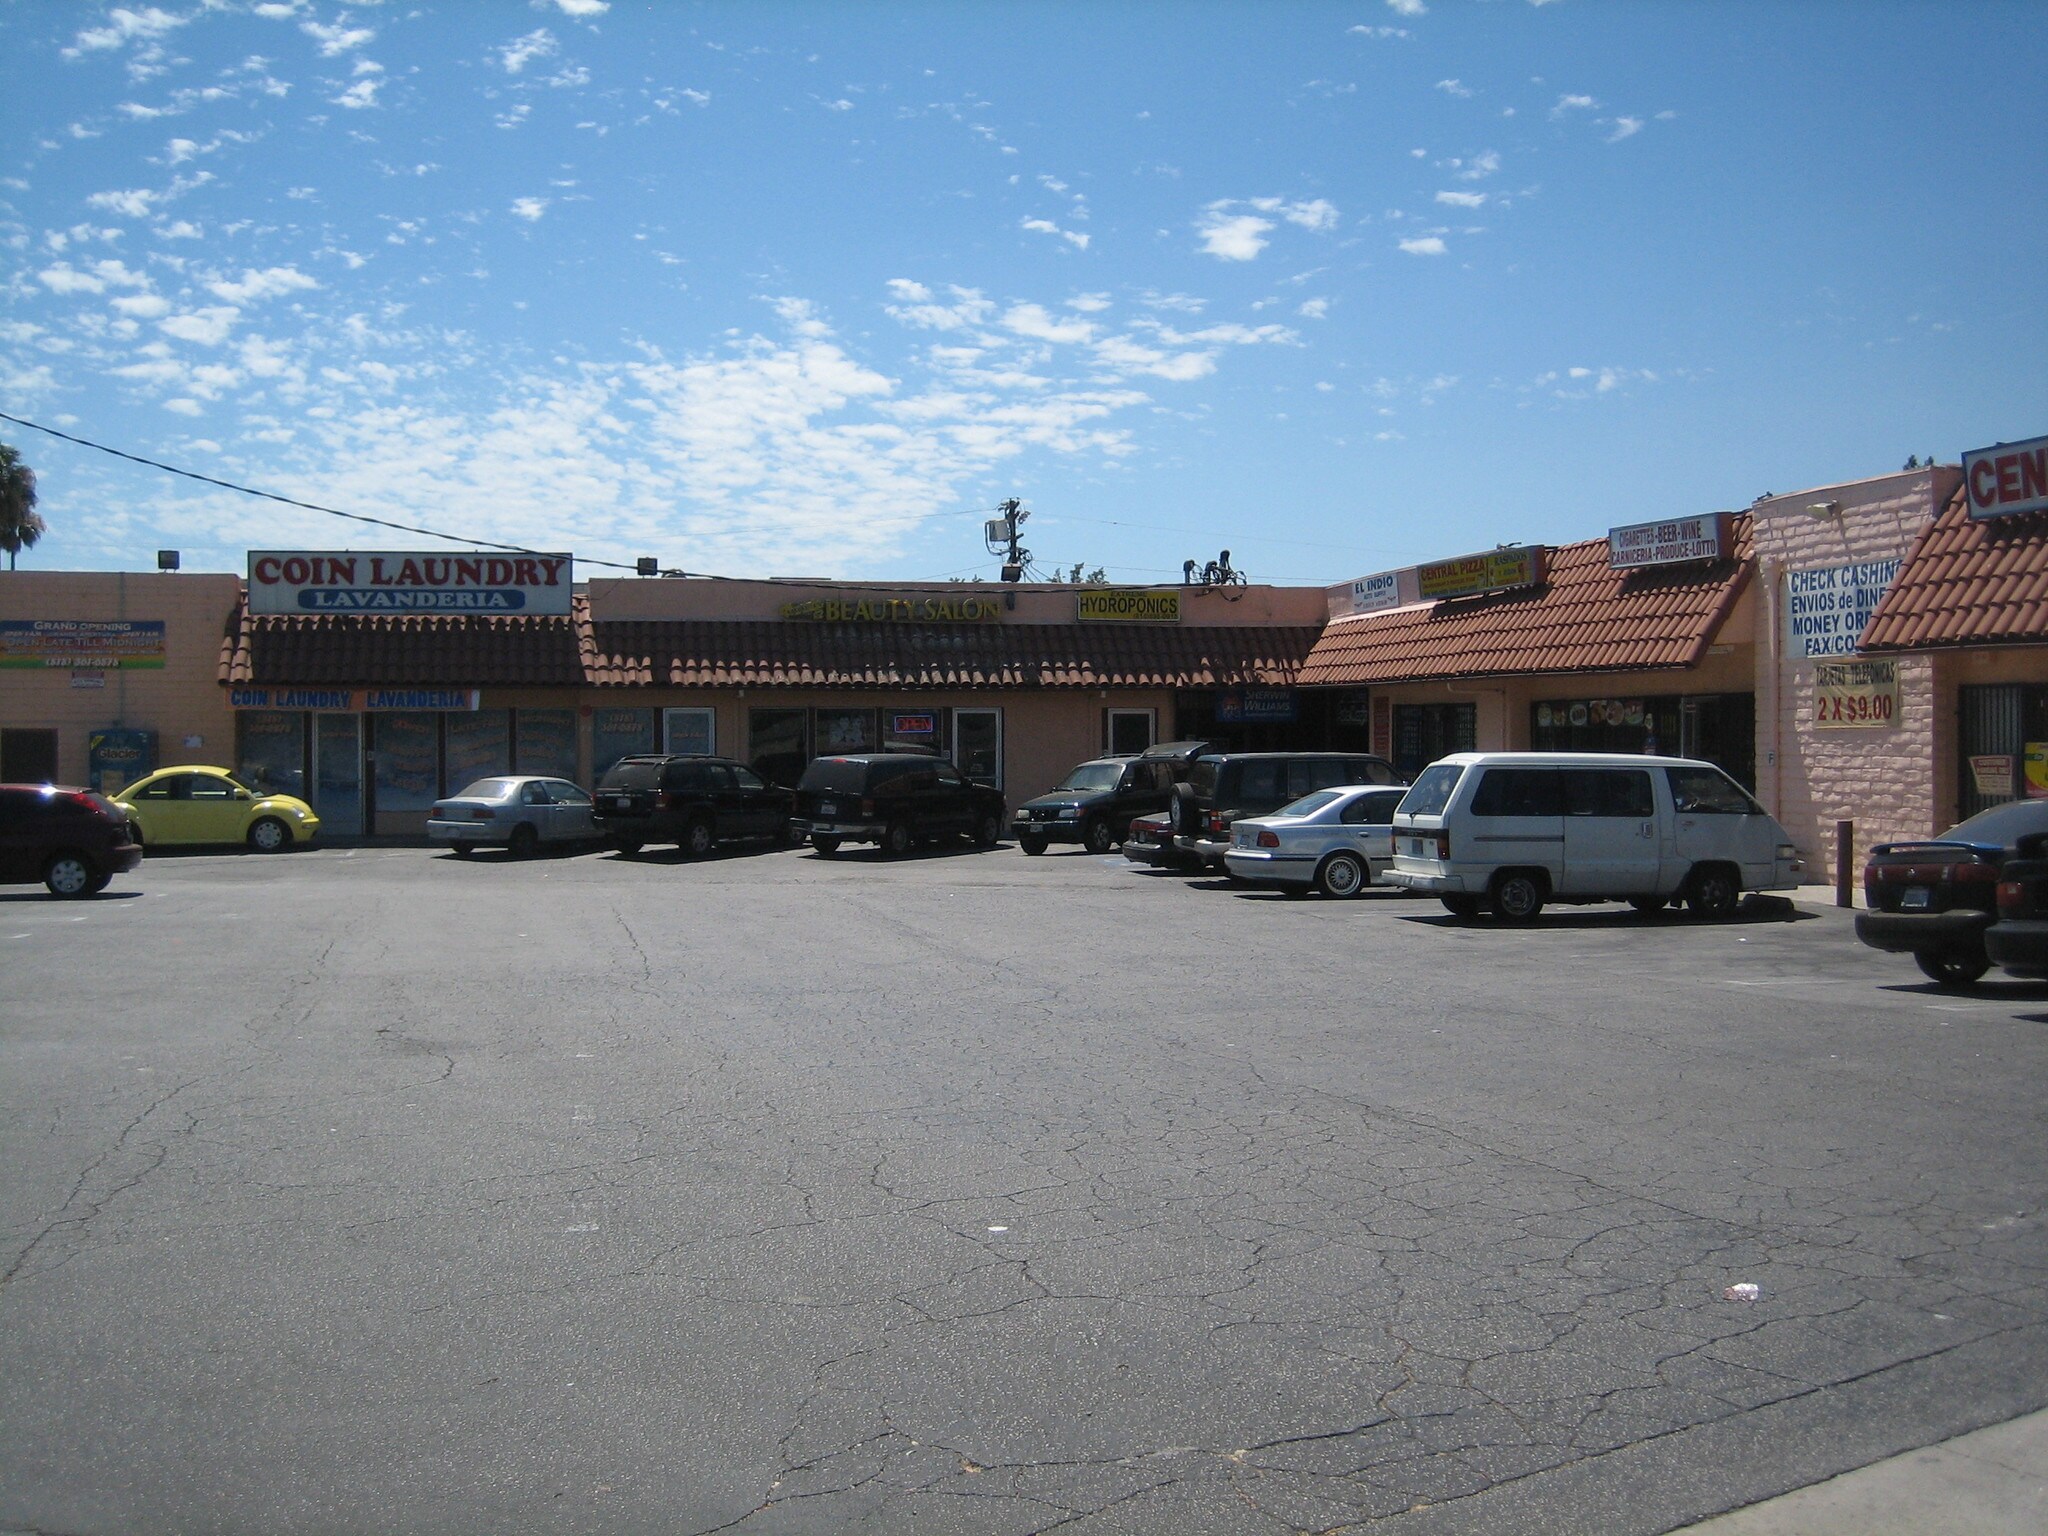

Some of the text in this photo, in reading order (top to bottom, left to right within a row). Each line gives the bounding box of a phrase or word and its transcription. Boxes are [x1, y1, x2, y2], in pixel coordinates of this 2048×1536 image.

[1970, 447, 2048, 508] CEN
[255, 557, 566, 587] COIN LAUNDRY
[1420, 563, 1459, 582] CENTRAL
[1460, 558, 1486, 575] PIZZA
[1355, 576, 1394, 594] EL INDIO
[1791, 568, 1836, 593] CHECK
[315, 591, 509, 608] LAVANDERIA
[1080, 597, 1178, 614] HYDROPONICS
[1791, 592, 1835, 614] ENVIOS
[1839, 592, 1853, 610] de
[825, 598, 916, 622] BEAUTY
[924, 598, 1000, 621] SALON
[34, 620, 132, 632] GRAND OPENING
[1793, 615, 1840, 636] MONEY
[7, 637, 161, 647] OPEN LATE TILL MIDNIGHT
[230, 690, 466, 709] COIN LAUNDRY LAVANDERIA
[1244, 700, 1291, 711] WILLIAMS
[1818, 694, 1892, 722] 2 X $9.00
[98, 747, 140, 759] Glacier
